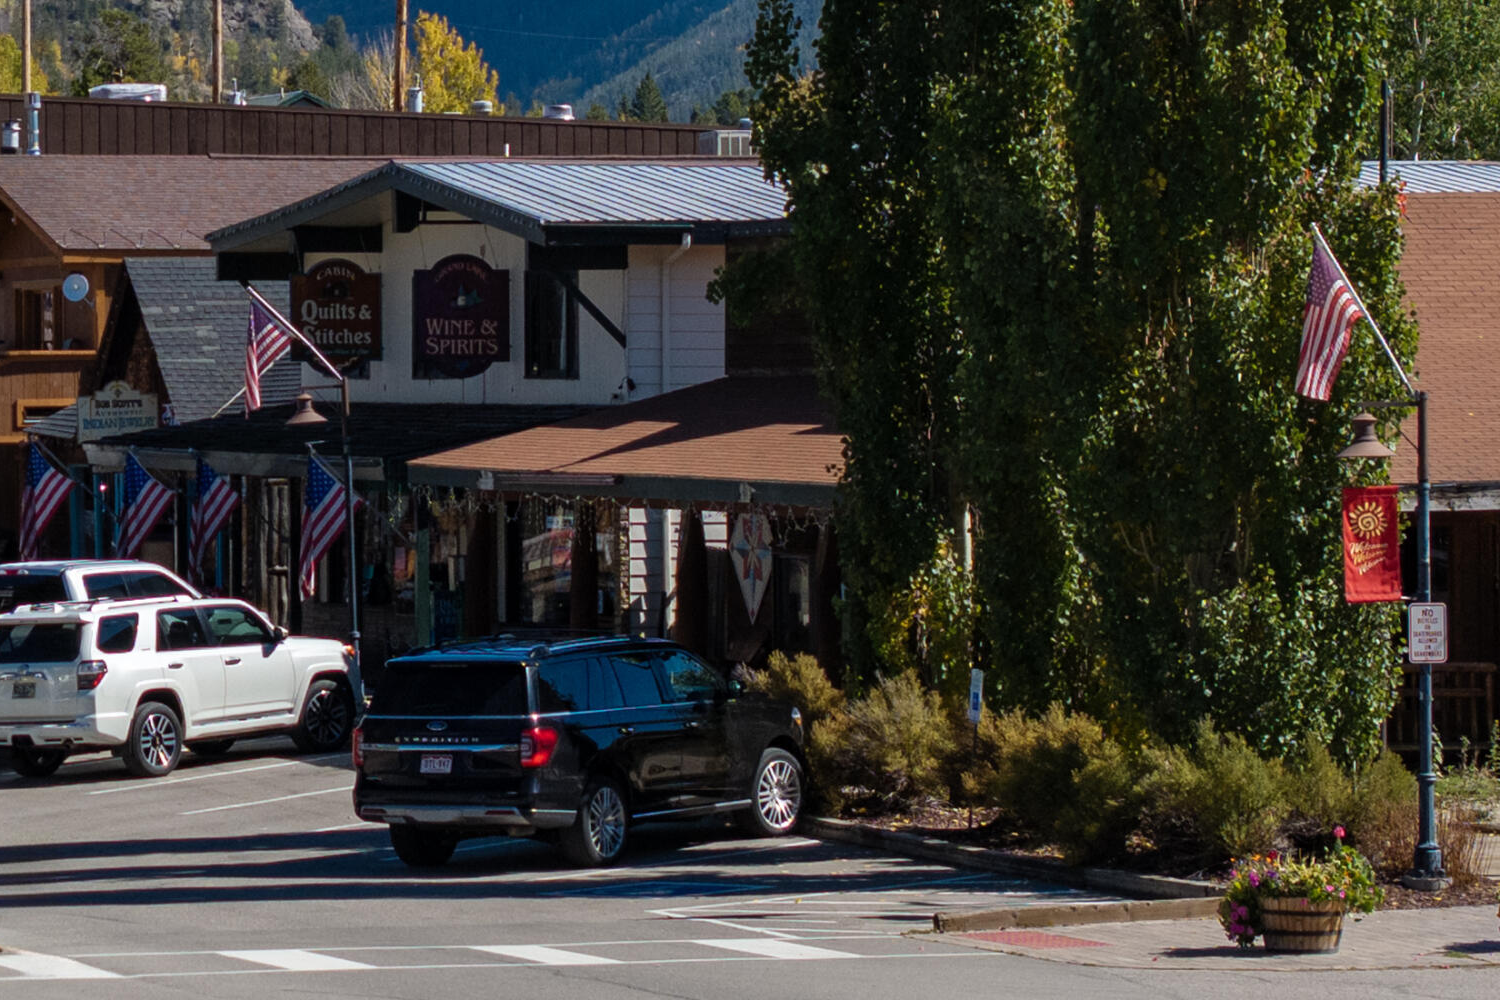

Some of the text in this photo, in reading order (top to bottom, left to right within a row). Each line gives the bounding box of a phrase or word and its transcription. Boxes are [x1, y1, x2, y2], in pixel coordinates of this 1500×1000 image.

[316, 267, 356, 280] CABIN
[301, 299, 372, 325] Quilts &
[302, 325, 372, 345] Stitches
[425, 318, 498, 336] WINE &
[425, 336, 498, 355] SPIRITS
[1421, 608, 1434, 617] NO
